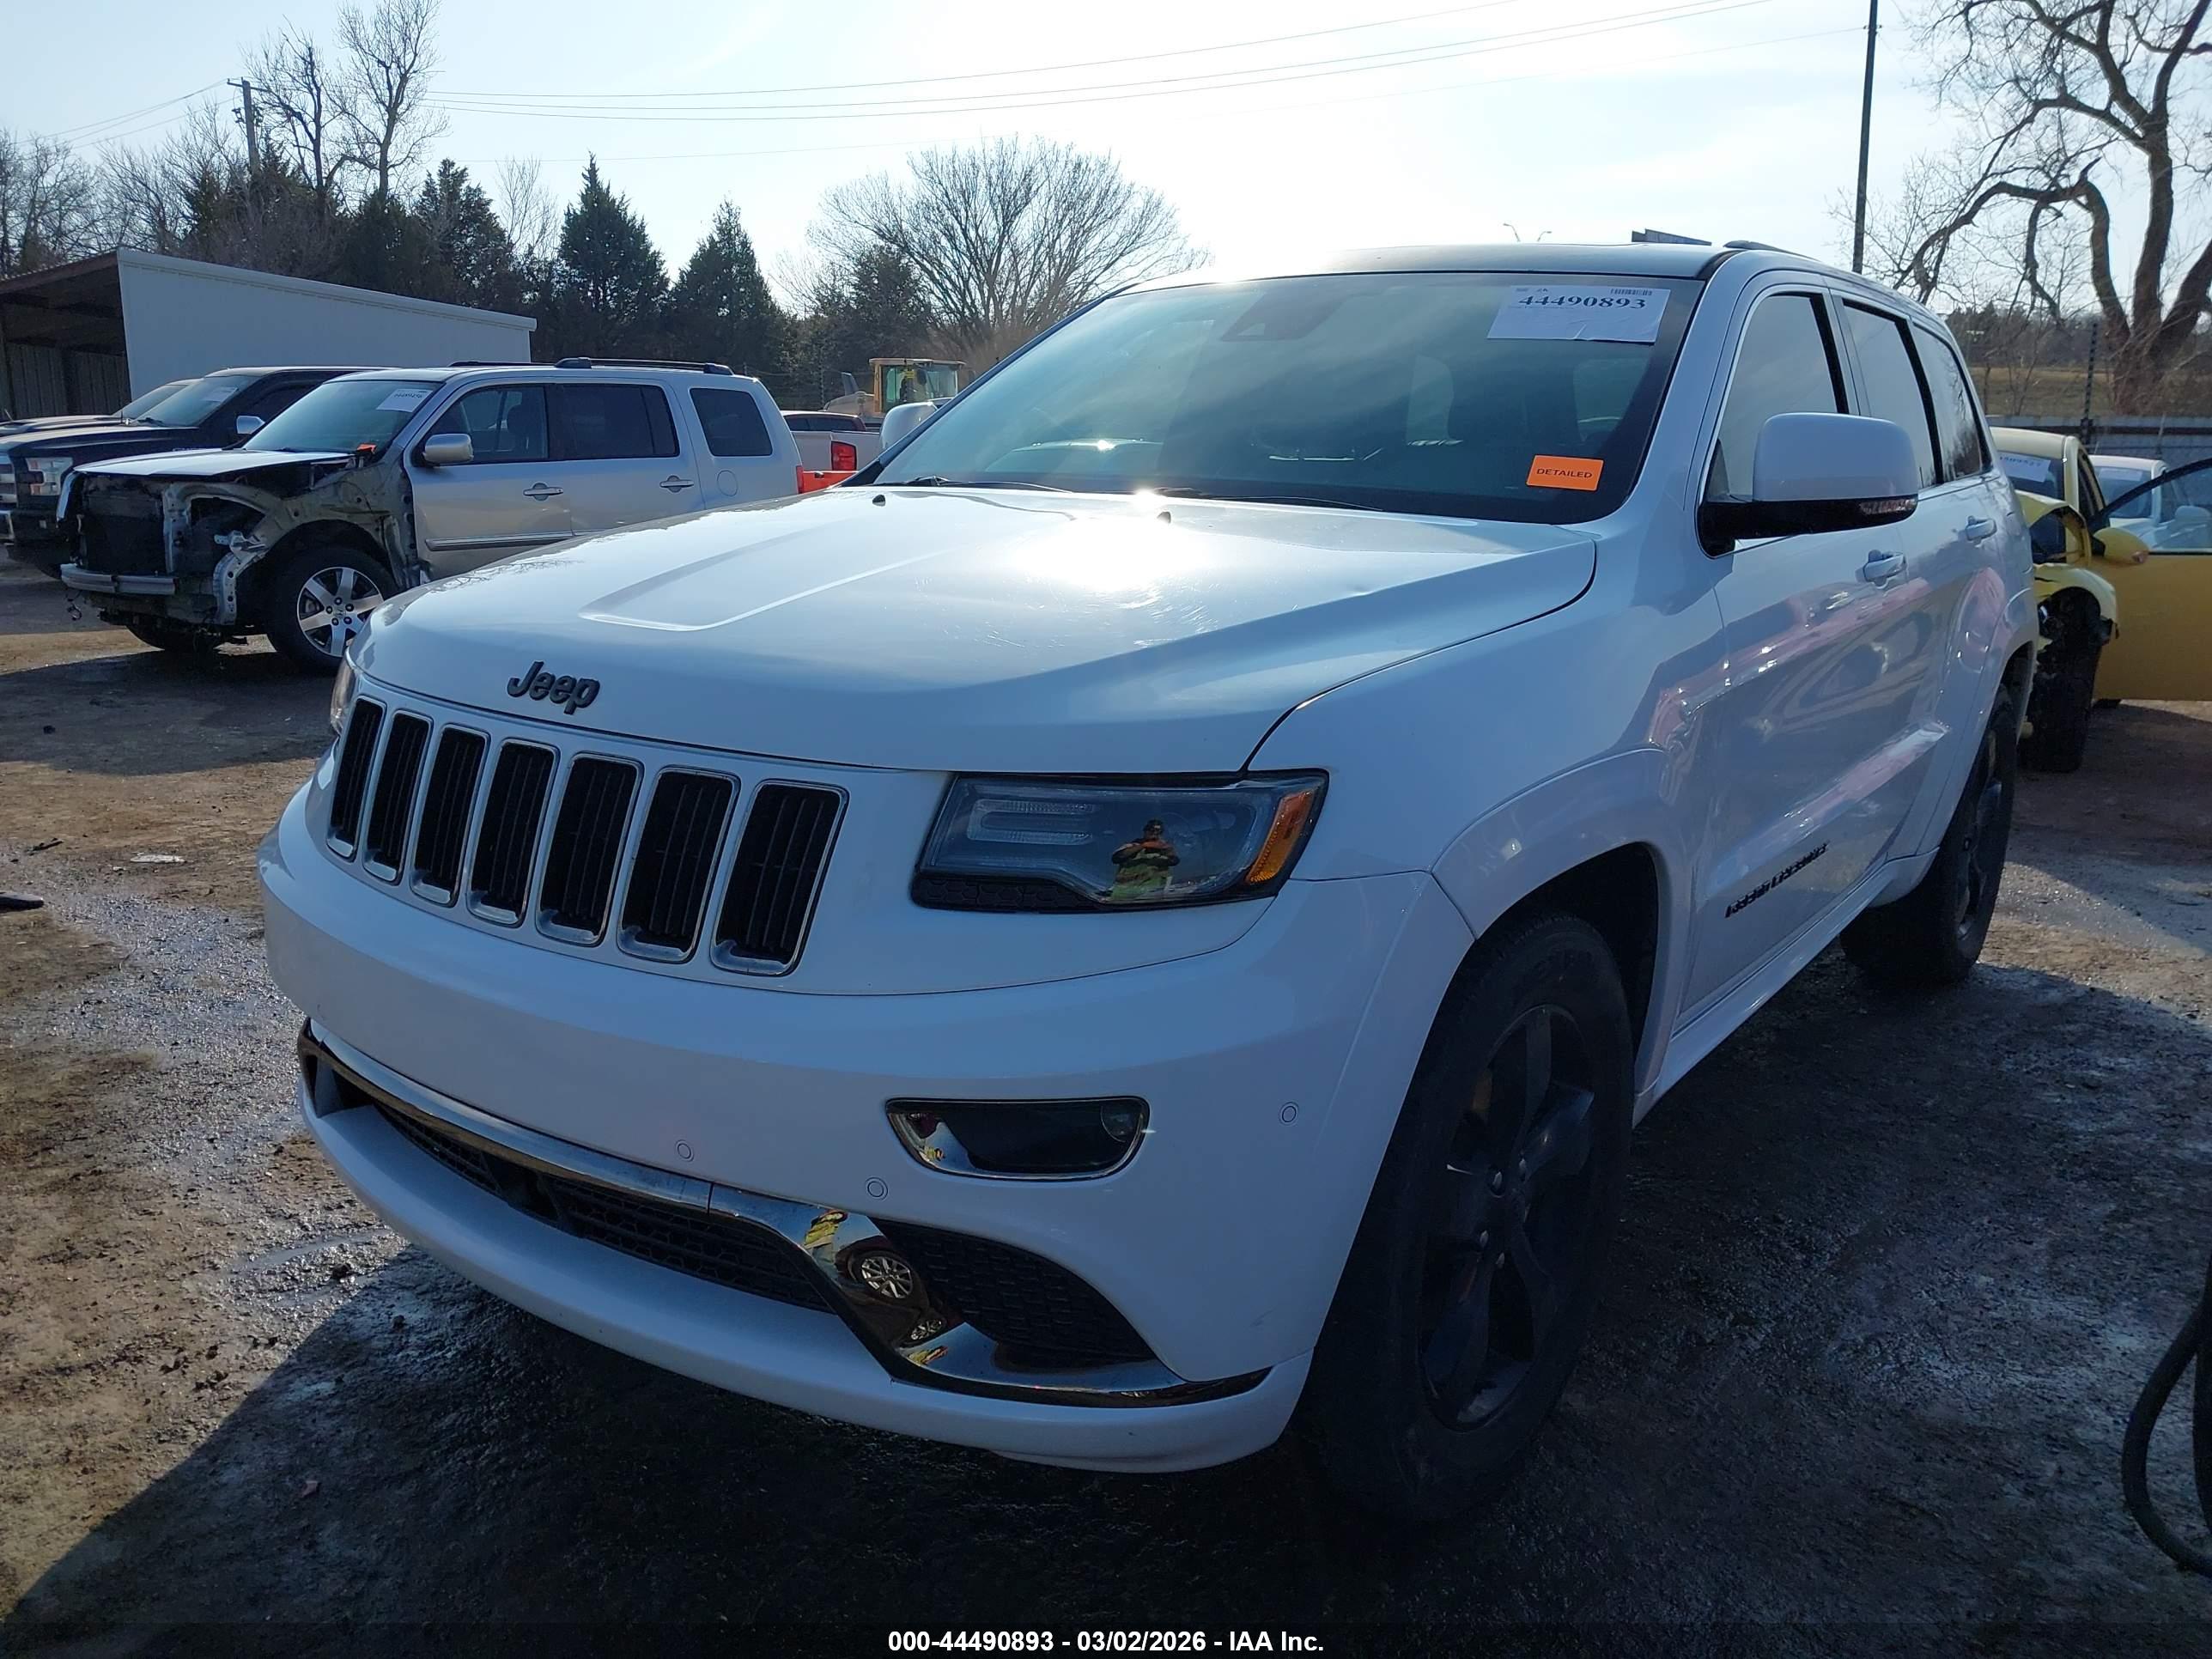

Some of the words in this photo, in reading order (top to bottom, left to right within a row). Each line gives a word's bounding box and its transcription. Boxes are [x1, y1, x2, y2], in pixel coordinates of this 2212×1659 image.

[1518, 295, 1646, 309] 44490893
[1536, 468, 1593, 478] DETAILED
[507, 660, 601, 715] Jeep
